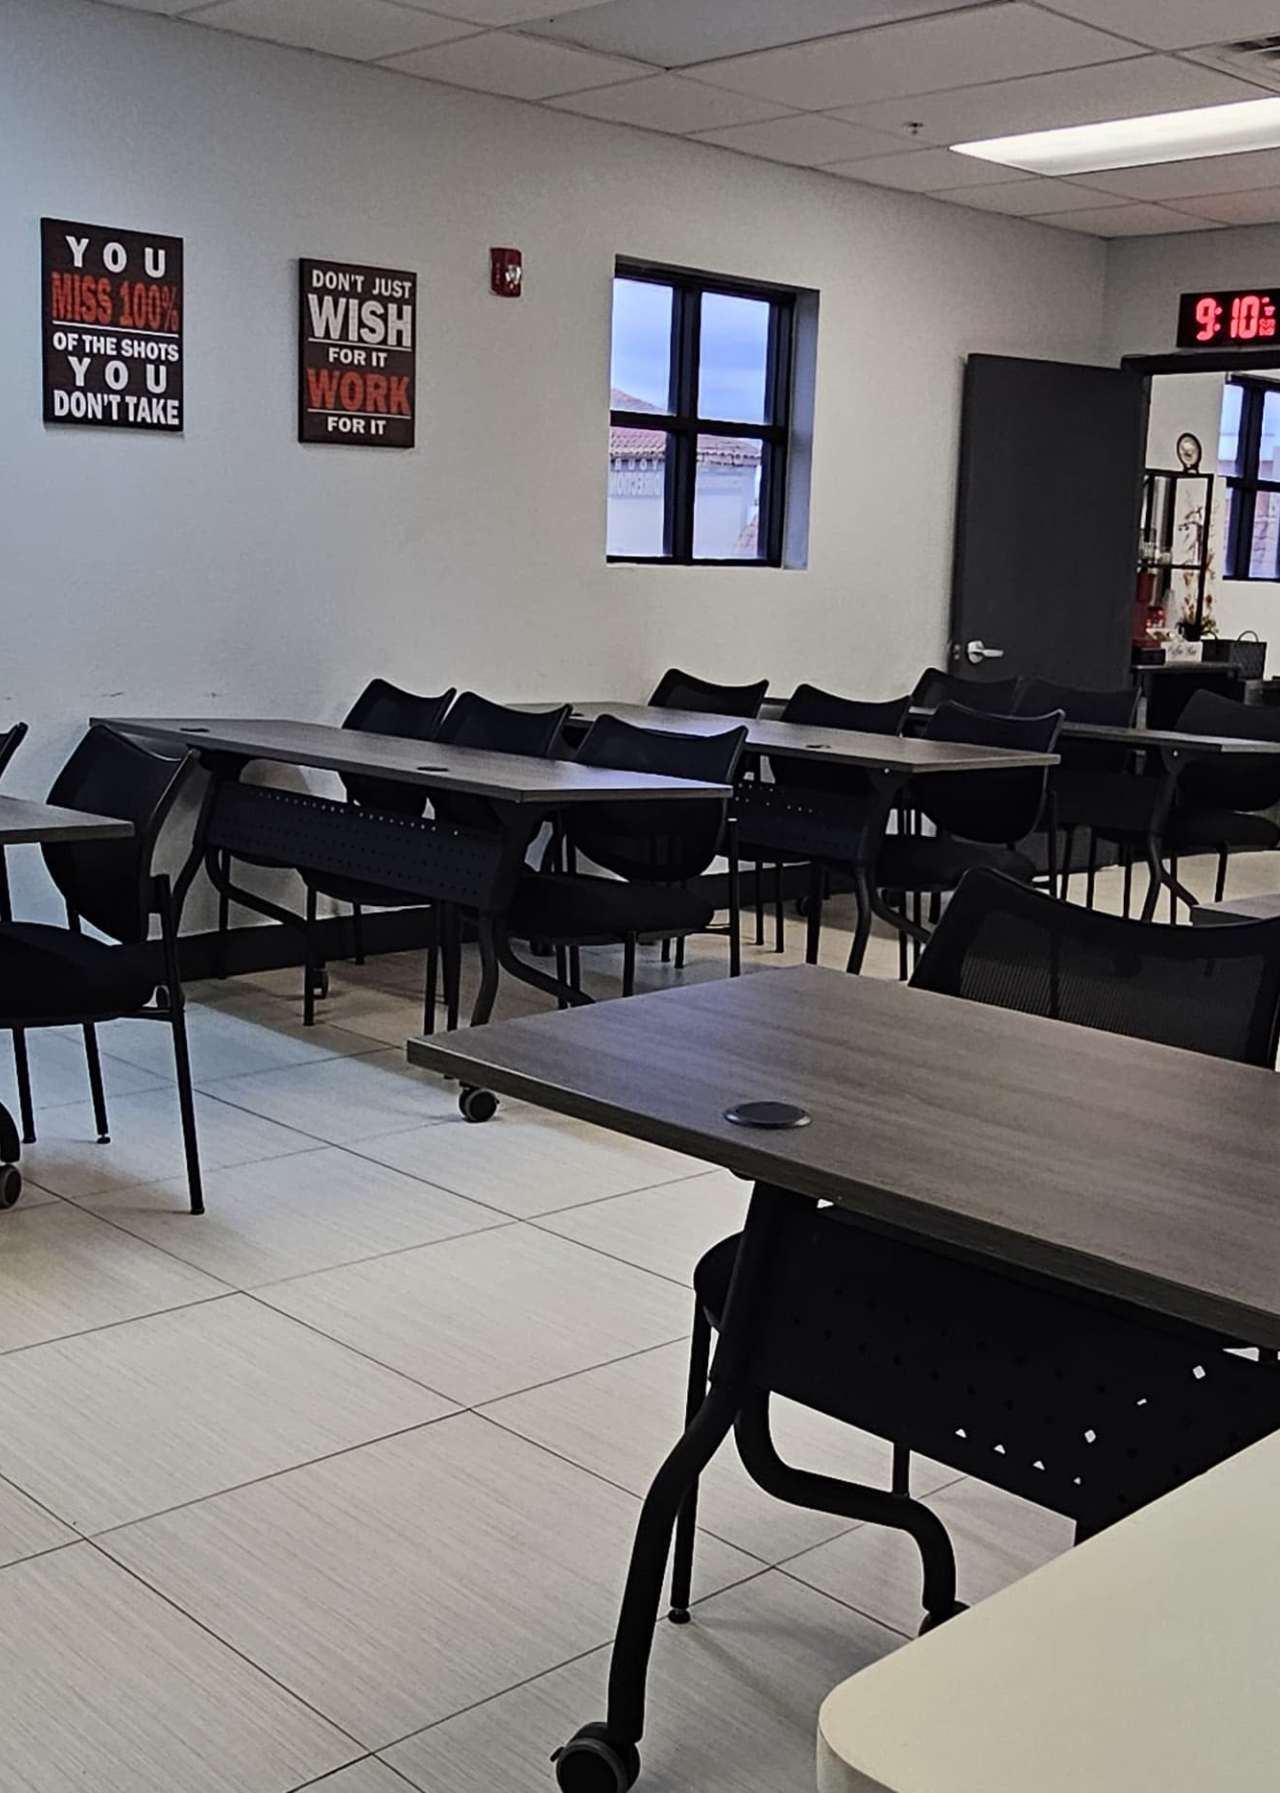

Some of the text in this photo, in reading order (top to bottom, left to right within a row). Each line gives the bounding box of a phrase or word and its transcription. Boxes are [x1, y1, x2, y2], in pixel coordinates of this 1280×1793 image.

[65, 235, 166, 278] YOU
[51, 272, 179, 332] MISS 100%
[312, 269, 412, 299] DON'T JUST
[307, 293, 412, 347] WISH
[1195, 295, 1260, 341] 9:10
[53, 332, 179, 361] OF THE SHOTS
[329, 348, 388, 367] FOR IT
[67, 356, 167, 393] YOU
[306, 368, 411, 415] WORK
[53, 389, 179, 425] DON'T TAKE
[327, 416, 386, 435] FOR IT
